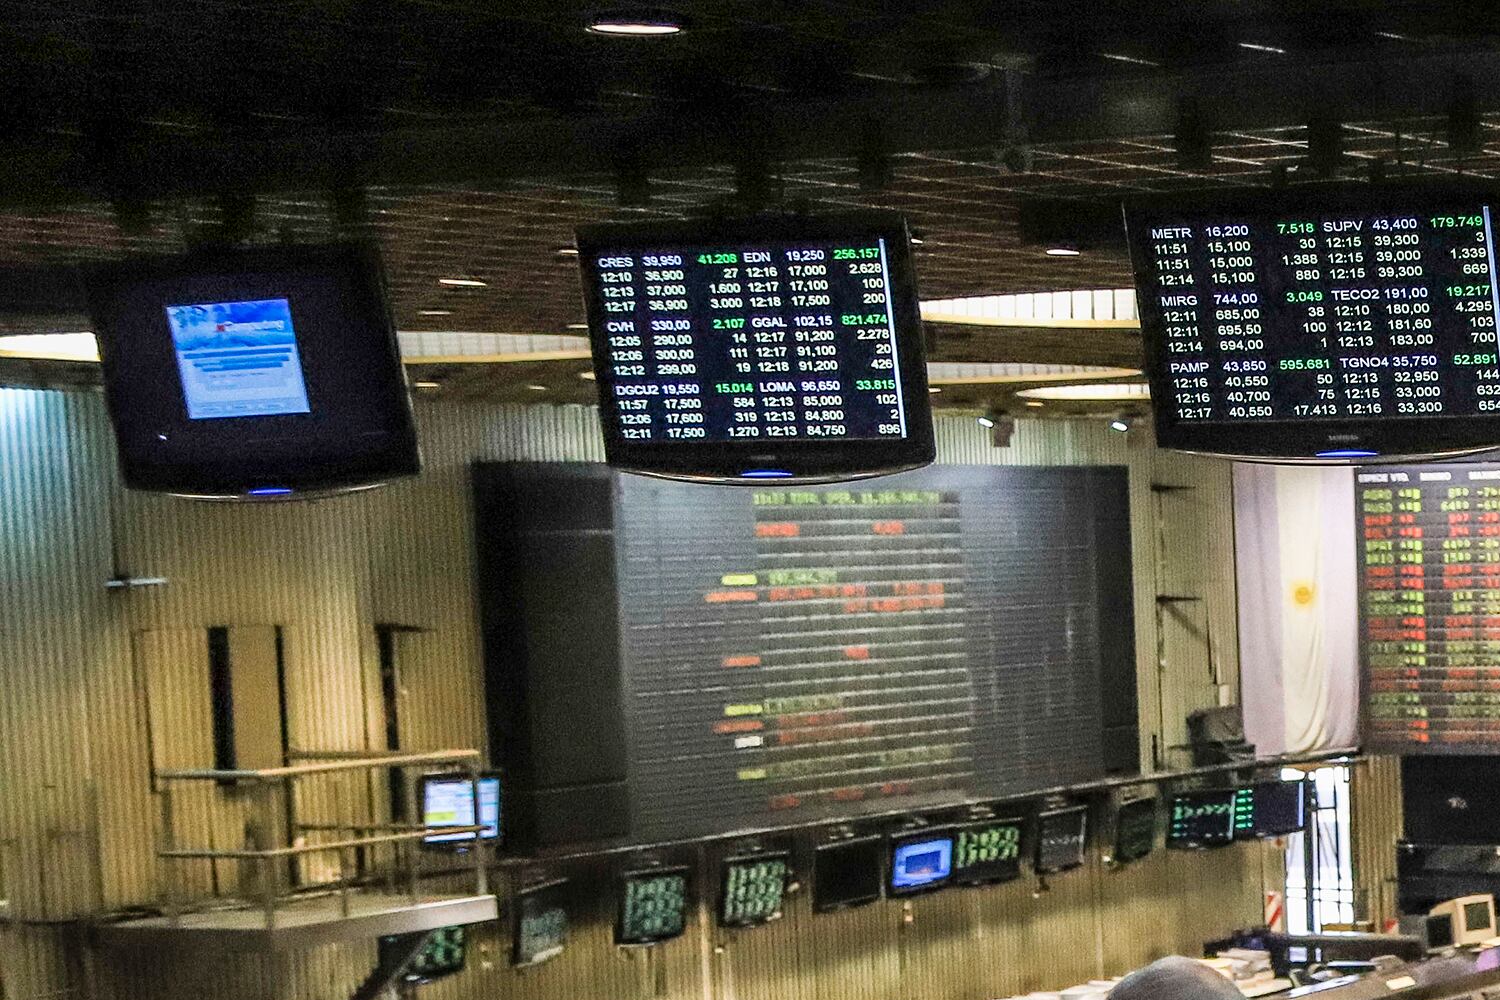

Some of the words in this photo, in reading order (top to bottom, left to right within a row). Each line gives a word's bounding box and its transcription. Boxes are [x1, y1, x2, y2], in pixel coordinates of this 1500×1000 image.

[1152, 228, 1191, 238] METR
[1206, 225, 1248, 237] 16,200
[1278, 223, 1314, 233] 7.518
[1324, 221, 1362, 232] SUPV
[1373, 219, 1417, 230] 43,400
[1430, 216, 1483, 228] 179.749
[1156, 244, 1186, 254] 11:51
[1208, 241, 1250, 252] 15,100
[1300, 239, 1315, 248] 30
[1327, 237, 1361, 247] 12:15
[1375, 235, 1418, 246] 39,300
[1476, 232, 1484, 242] 3
[599, 257, 633, 267] CRES
[643, 255, 682, 266] 39,950
[743, 252, 770, 262] EDN
[786, 250, 824, 261] 19,250
[834, 248, 879, 260] 256.157
[1162, 296, 1197, 306] MIRG
[1214, 293, 1257, 304] 744,00
[1287, 292, 1322, 302] 3.049
[1331, 289, 1380, 300] TECO2
[1384, 287, 1427, 300] 191,00
[1447, 285, 1490, 296] 19.217
[607, 322, 634, 332] CVH
[651, 320, 690, 331] 330,00
[714, 318, 744, 329] 2.107
[752, 317, 787, 327] GGAL
[794, 315, 832, 327] 102,15
[842, 313, 887, 327] 821.474
[1171, 363, 1209, 372] PAMP
[1223, 361, 1266, 372] 43,850
[1280, 359, 1329, 369] 595.681
[1340, 357, 1388, 369] TGNO4
[1392, 356, 1437, 368] 35,750
[1454, 354, 1498, 365] 52.891
[616, 385, 659, 395] DGCU2
[662, 384, 699, 395] 19,550
[716, 383, 753, 393] 15.014
[760, 382, 796, 392] LOMA
[801, 381, 840, 392] 96,650
[856, 379, 895, 391] 33.815
[1174, 378, 1207, 388] 12:16
[1226, 376, 1268, 387] 40,550
[1318, 374, 1332, 384] 50
[1343, 373, 1377, 383] 12:13
[1395, 371, 1438, 382] 32,950
